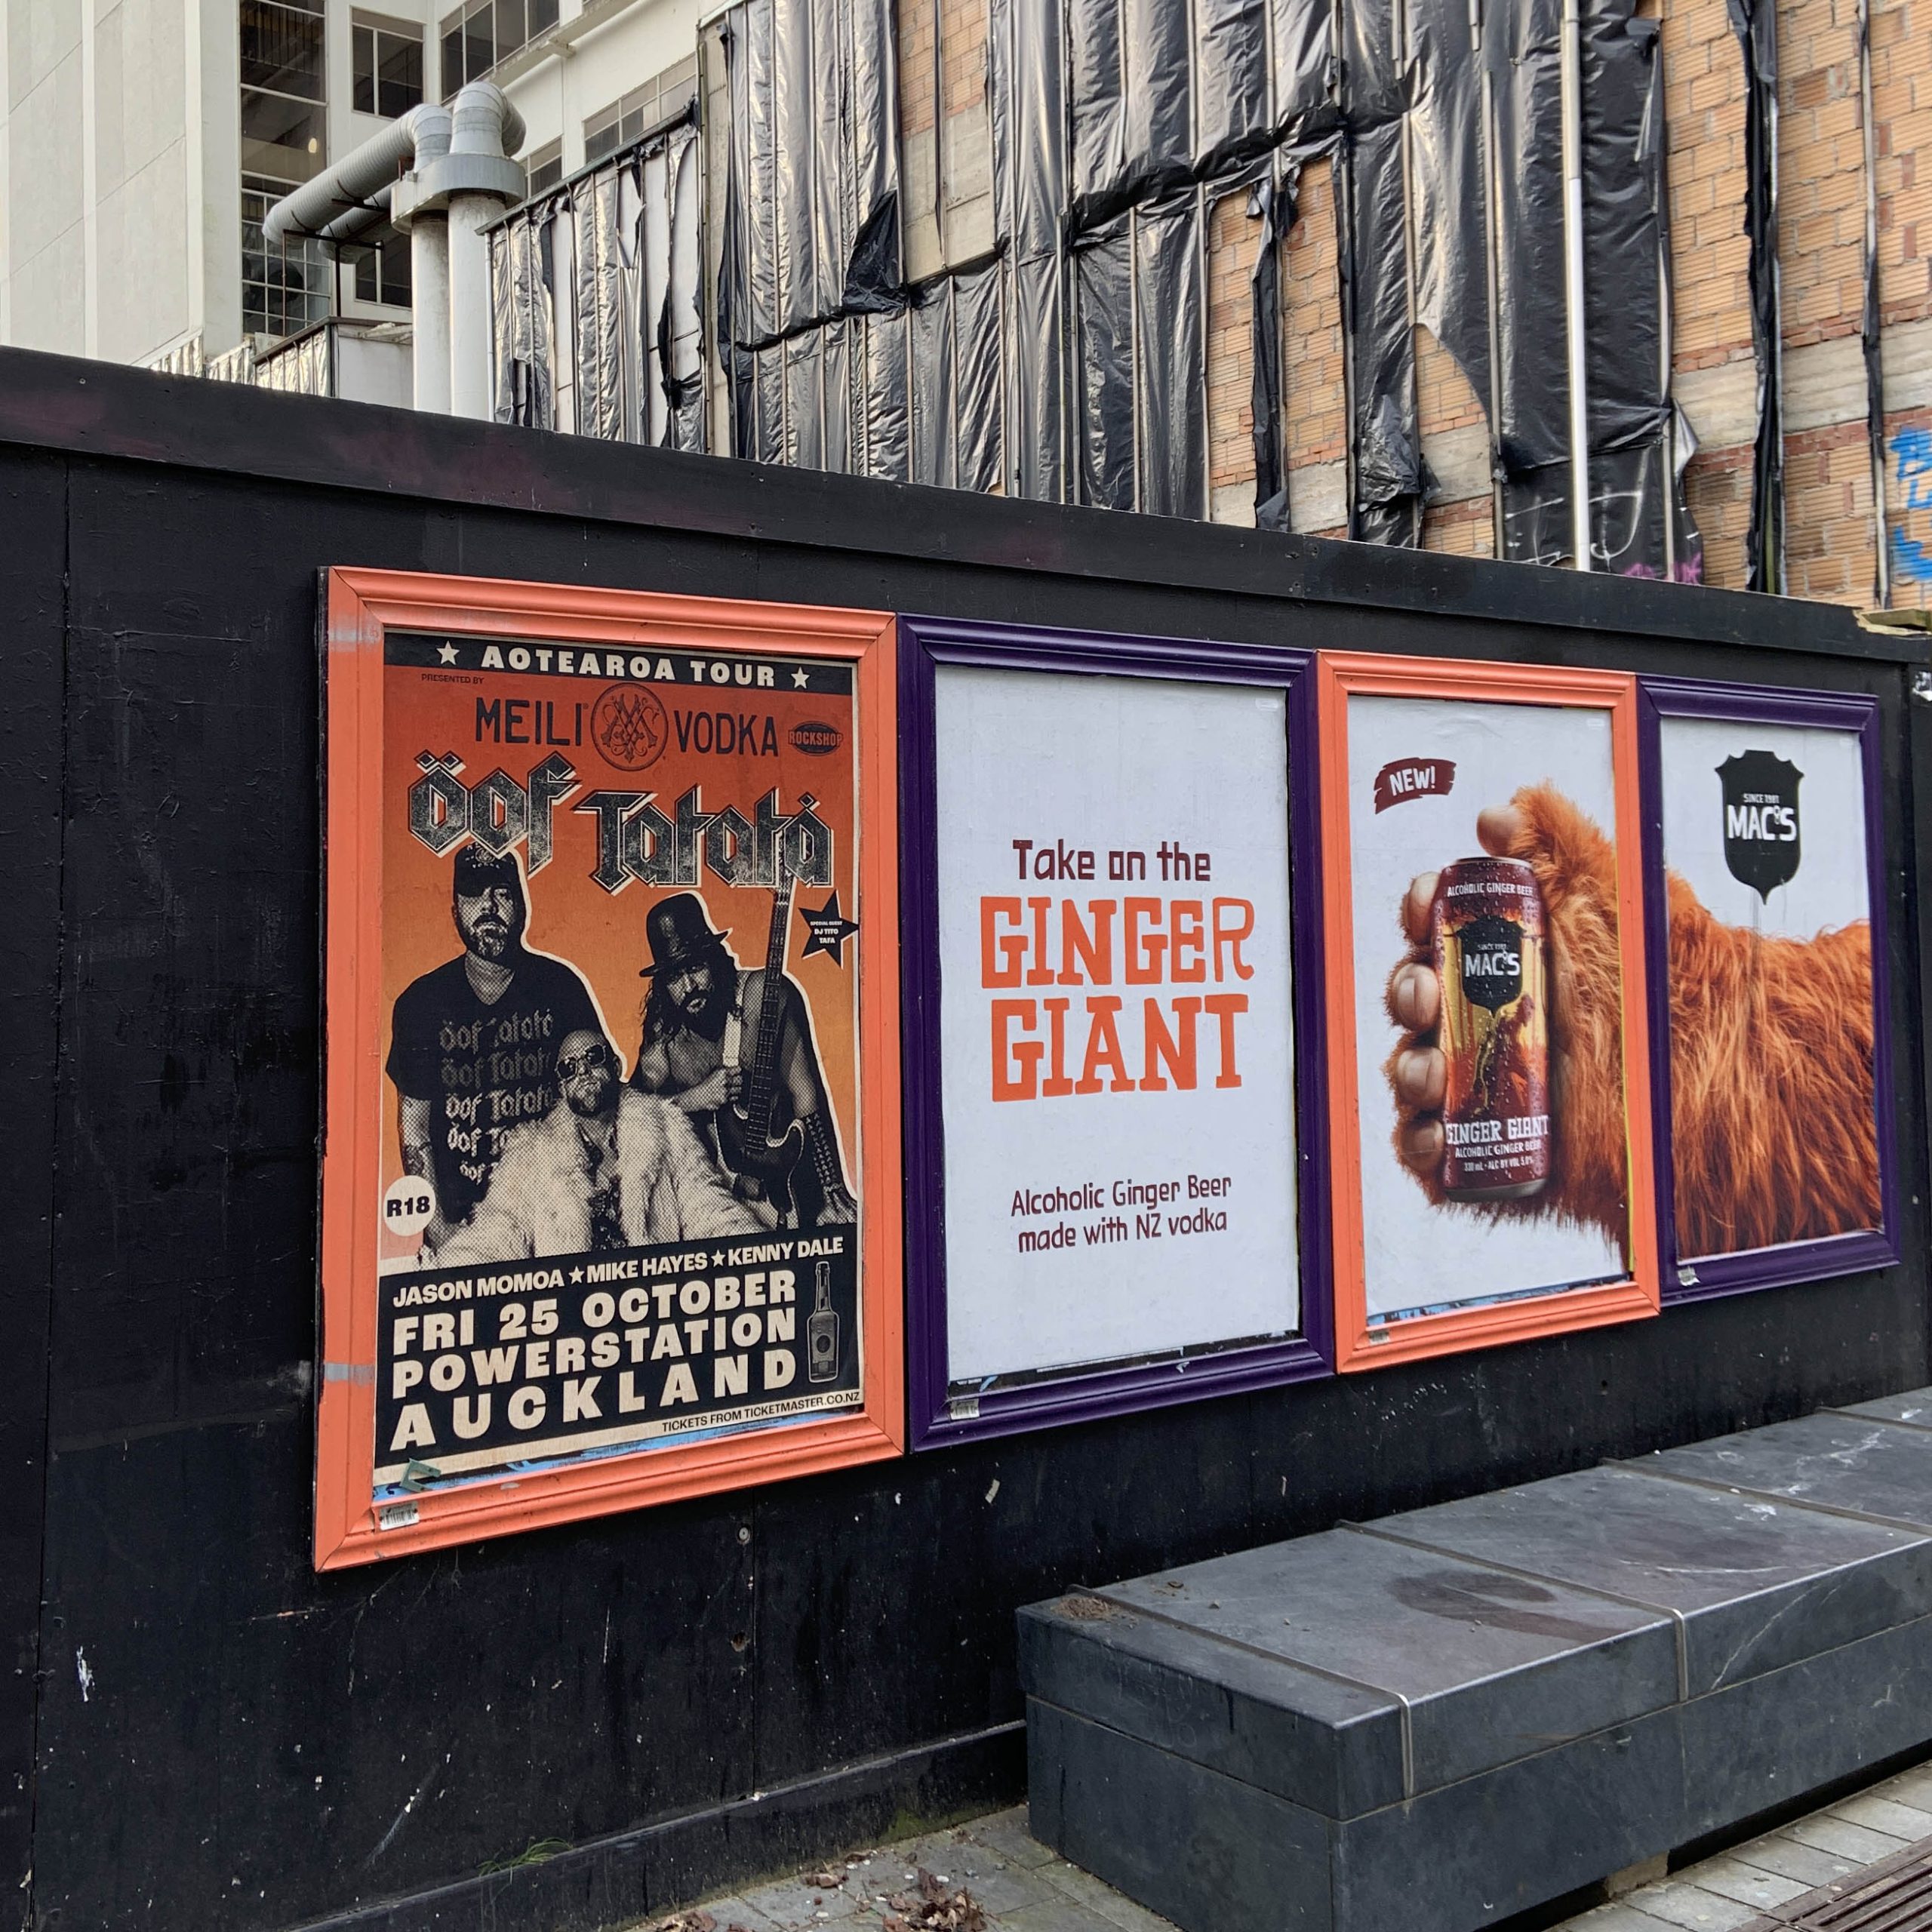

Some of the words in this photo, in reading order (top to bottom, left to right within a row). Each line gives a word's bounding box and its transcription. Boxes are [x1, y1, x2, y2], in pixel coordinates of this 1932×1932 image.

[421, 673, 471, 684] PRESENTED
[472, 676, 485, 685] BY
[481, 645, 675, 681] AOTEAROA
[689, 660, 775, 688] TOUR
[475, 697, 582, 746] MEILI
[674, 710, 779, 757] VODKA
[788, 730, 843, 747] ROCKSHOP
[1389, 766, 1436, 796] NEW!
[1743, 792, 1764, 804] SINCE
[1727, 804, 1797, 842] MAC'S
[1012, 838, 1096, 880] Take
[1109, 851, 1146, 881] on
[1156, 841, 1211, 881] the
[1447, 882, 1485, 897] ALCOHOLIC
[1487, 882, 1515, 894] GINGER
[980, 896, 1255, 989] GINGER
[1465, 951, 1521, 977] MAC'S
[991, 993, 1249, 1103] GIANT
[1445, 1119, 1503, 1145] GINGER
[1507, 1115, 1549, 1140] GIANT
[1455, 1145, 1494, 1158] ALCOHOLIC
[1494, 1142, 1524, 1155] GINGER
[1487, 1160, 1499, 1170] ALC
[1500, 1158, 1508, 1168] BY
[386, 1195, 430, 1217] R18
[1011, 1182, 1105, 1217] Alcoholic
[1112, 1179, 1180, 1210] Ginger
[1187, 1174, 1232, 1199] Beer
[1018, 1221, 1076, 1253] made
[1084, 1217, 1128, 1245] with
[1136, 1214, 1161, 1239] NZ
[1168, 1208, 1228, 1235] vodka
[392, 1279, 472, 1307] JASON
[477, 1269, 565, 1297] MOMOA
[586, 1260, 638, 1283] MIKE
[642, 1252, 708, 1276] HAYES
[728, 1241, 795, 1266] KENNY
[797, 1236, 844, 1258] DALE
[393, 1309, 475, 1355] FRI
[499, 1298, 559, 1341] 25
[582, 1269, 796, 1328] OCTOBER
[392, 1307, 796, 1400] POWERSTATION
[389, 1348, 796, 1451] AUCKLAND
[662, 1416, 708, 1432] TICKETS
[710, 1412, 742, 1424] FROM
[744, 1392, 860, 1419] TICKETMASTER.CO.NZ
